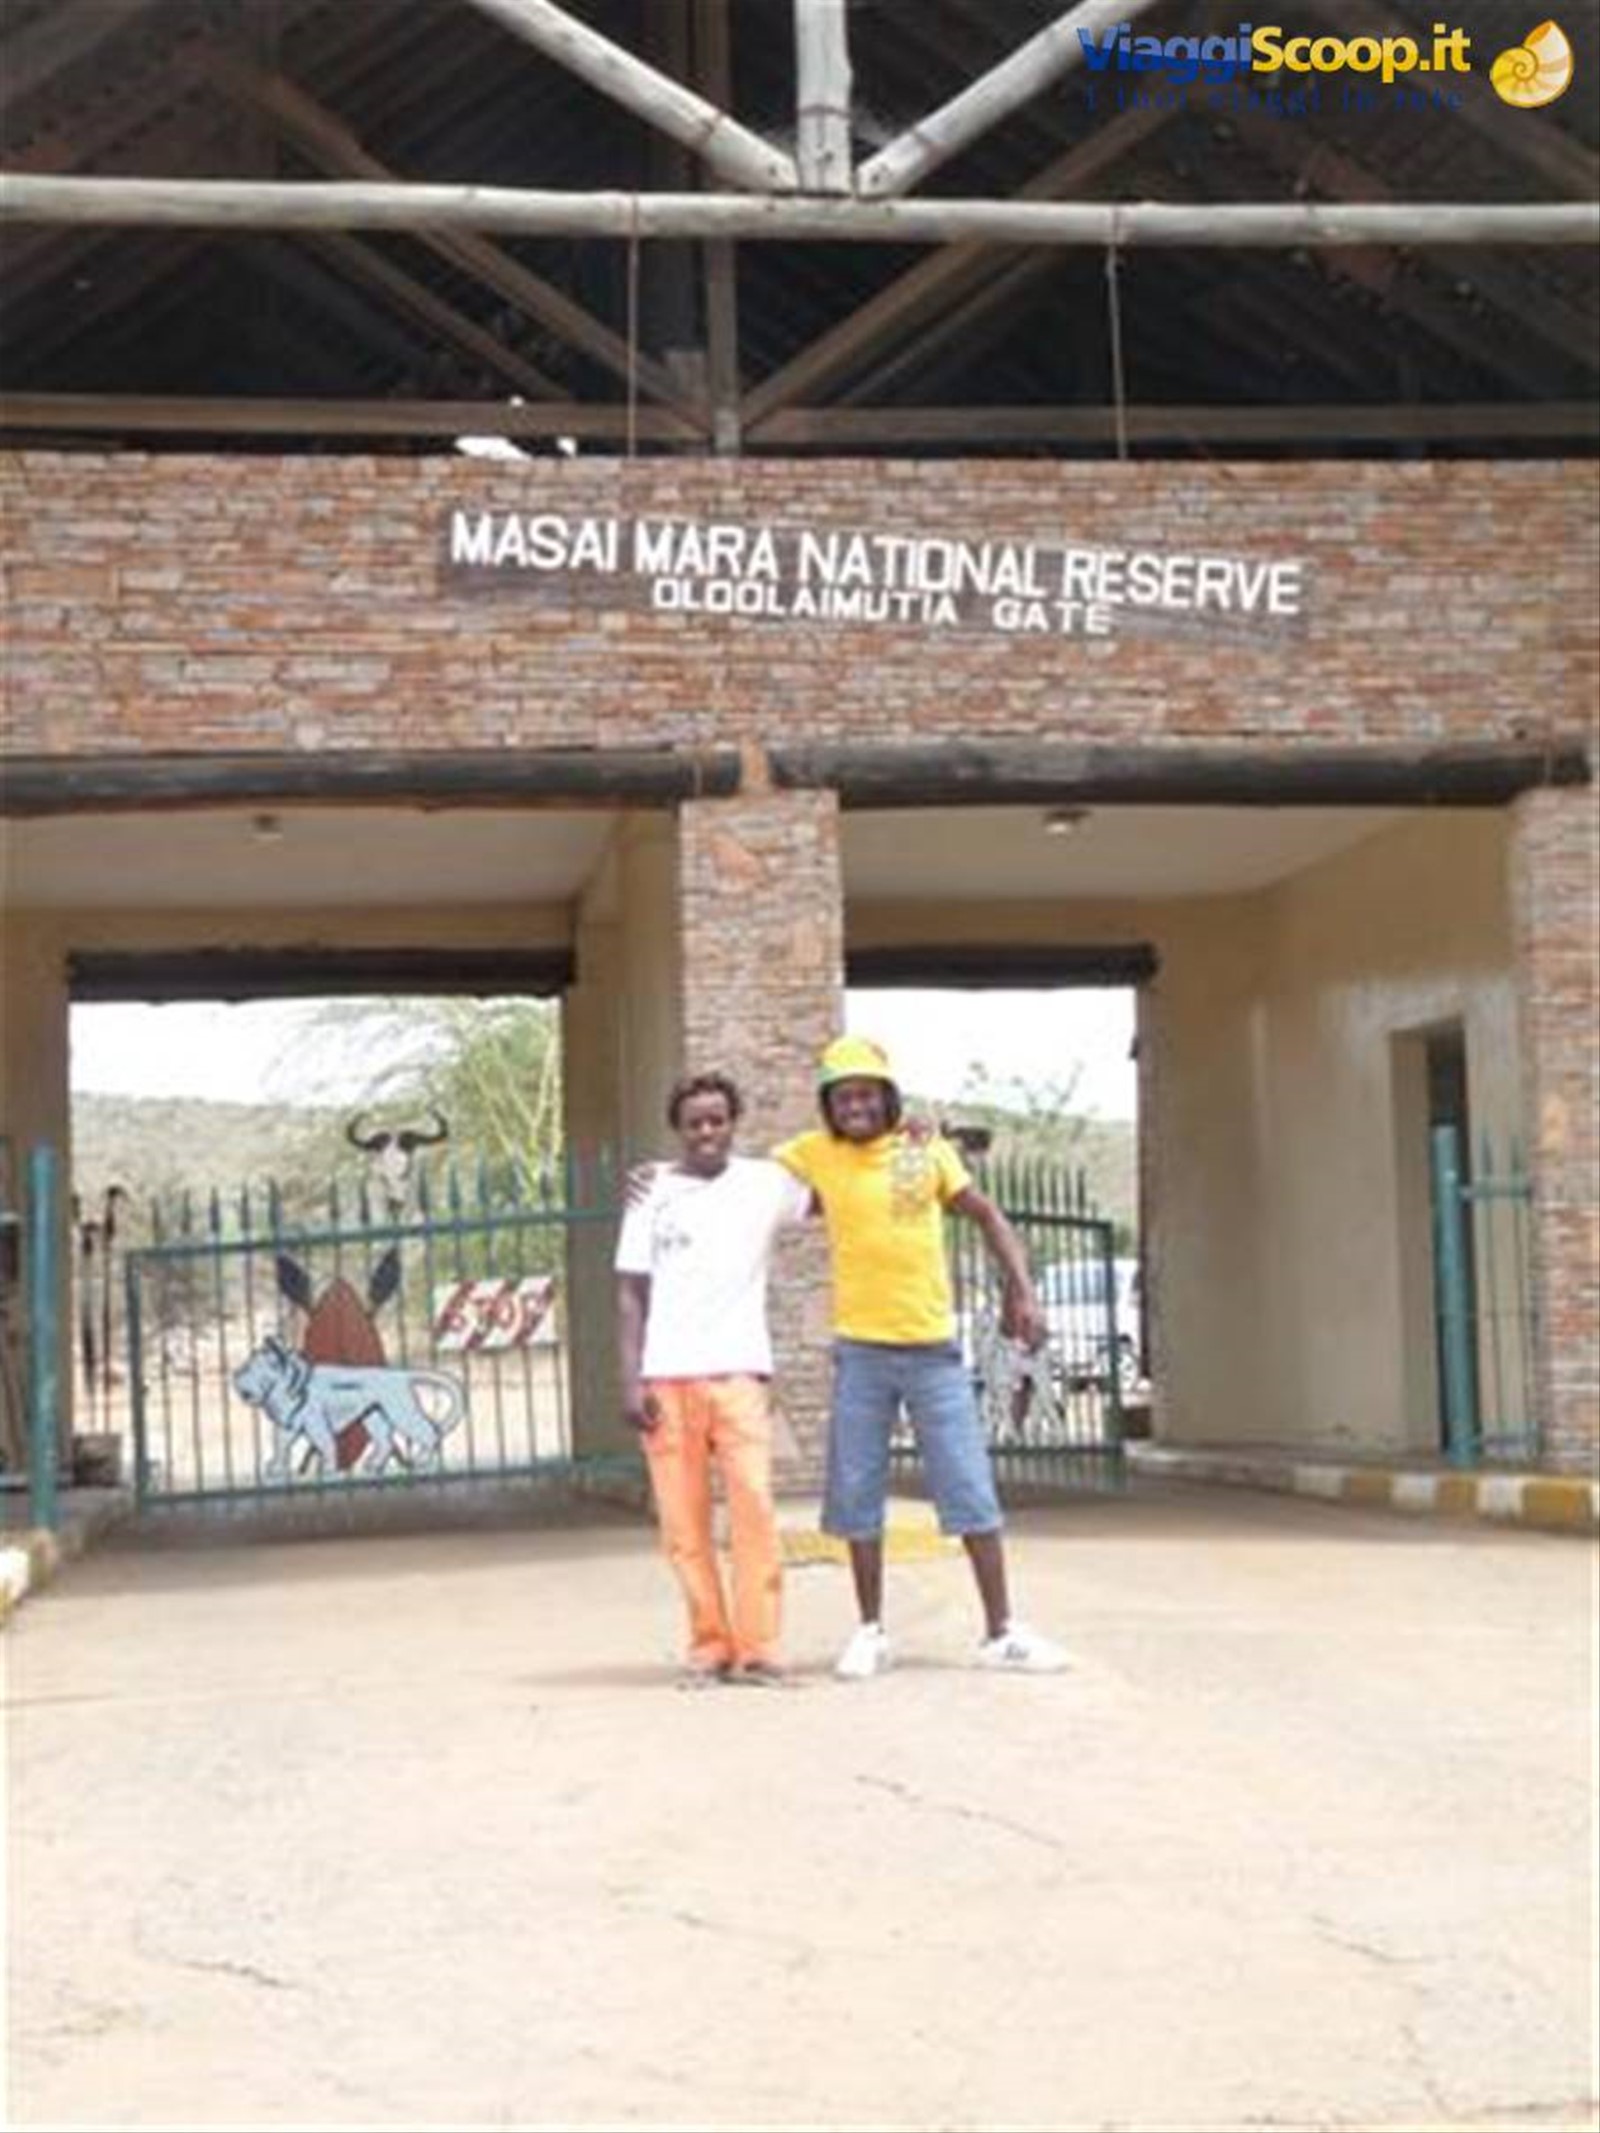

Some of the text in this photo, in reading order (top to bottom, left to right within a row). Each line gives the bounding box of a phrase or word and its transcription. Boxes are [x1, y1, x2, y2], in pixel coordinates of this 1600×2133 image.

[451, 511, 1301, 615] MASAI MARA NATIONAL RESERVE
[652, 577, 1115, 635] OLOOLAIMUTIA GATE
